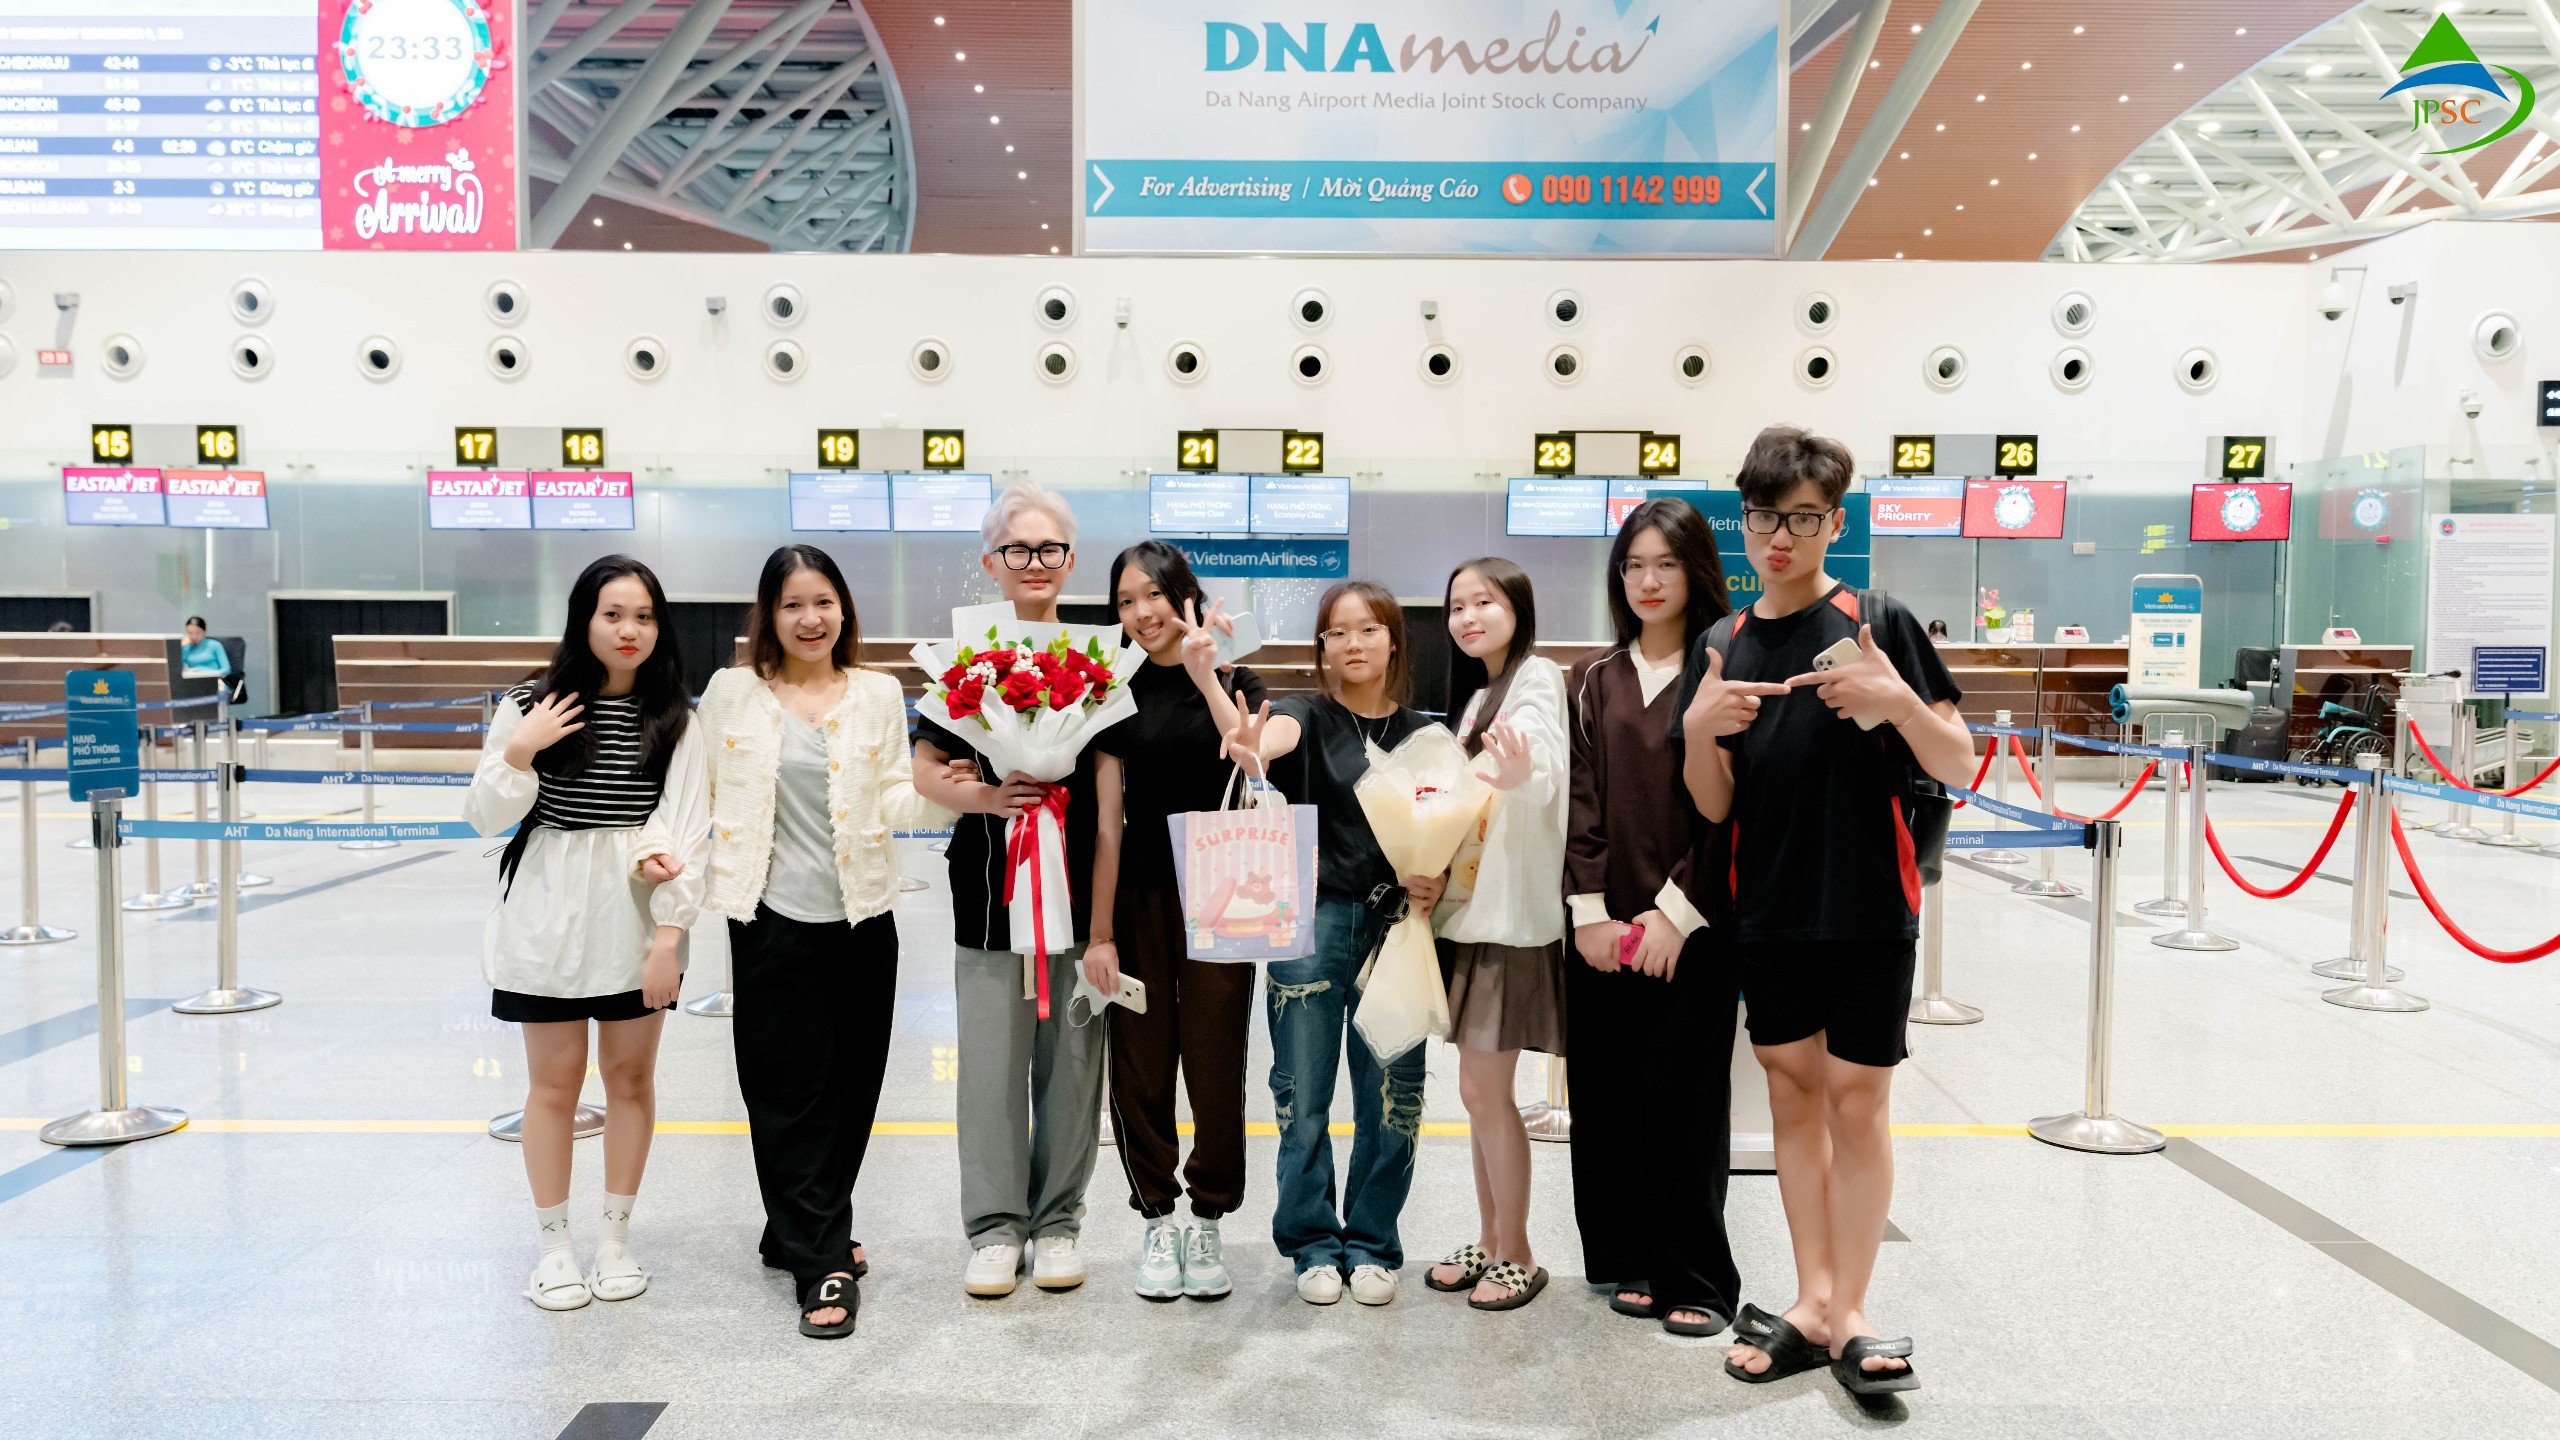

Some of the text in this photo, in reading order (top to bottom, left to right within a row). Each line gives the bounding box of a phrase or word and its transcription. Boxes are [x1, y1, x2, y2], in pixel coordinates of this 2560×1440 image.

[368, 36, 462, 60] 23:33
[1205, 90, 1648, 114] Da Nang Airport Media Joint Stock Company
[1139, 176, 1175, 198] For
[1178, 177, 1292, 202] Advertising
[1319, 177, 1362, 199] Mời
[1367, 178, 1433, 202] Quảng
[1438, 177, 1479, 199] Cáo
[1542, 175, 1591, 204] 090
[1599, 175, 1664, 204] 1142
[1672, 175, 1721, 204] 999
[355, 172, 483, 240] Arrival
[94, 430, 130, 458] 15
[200, 430, 235, 458] 16
[459, 433, 493, 460] 17
[566, 434, 600, 461] 18
[821, 435, 855, 462] 19
[927, 436, 962, 463] 20
[1182, 438, 1215, 465] 21
[1286, 439, 1320, 466] 22
[1539, 441, 1571, 468] 23
[1643, 441, 1677, 467] 24
[1897, 442, 1931, 468] 25
[2000, 442, 2034, 468] 26
[2228, 444, 2262, 469] 27
[66, 476, 159, 493] EASTAR JET
[168, 479, 261, 496] EASTAR JET
[431, 480, 526, 496] EASTAR JET
[535, 480, 629, 497] EASTAR JET
[1877, 503, 1901, 512] SKY
[1877, 512, 1932, 521] PRIORITY
[1707, 517, 1742, 531] ietn
[156, 771, 207, 781] International
[321, 774, 473, 786] AHT Da Nang International Termin
[2477, 795, 2490, 805] AHT
[224, 825, 439, 841] AHT Da Nang International Terminal
[1195, 827, 1290, 852] SURPRISE
[1946, 834, 1984, 845] erminal
